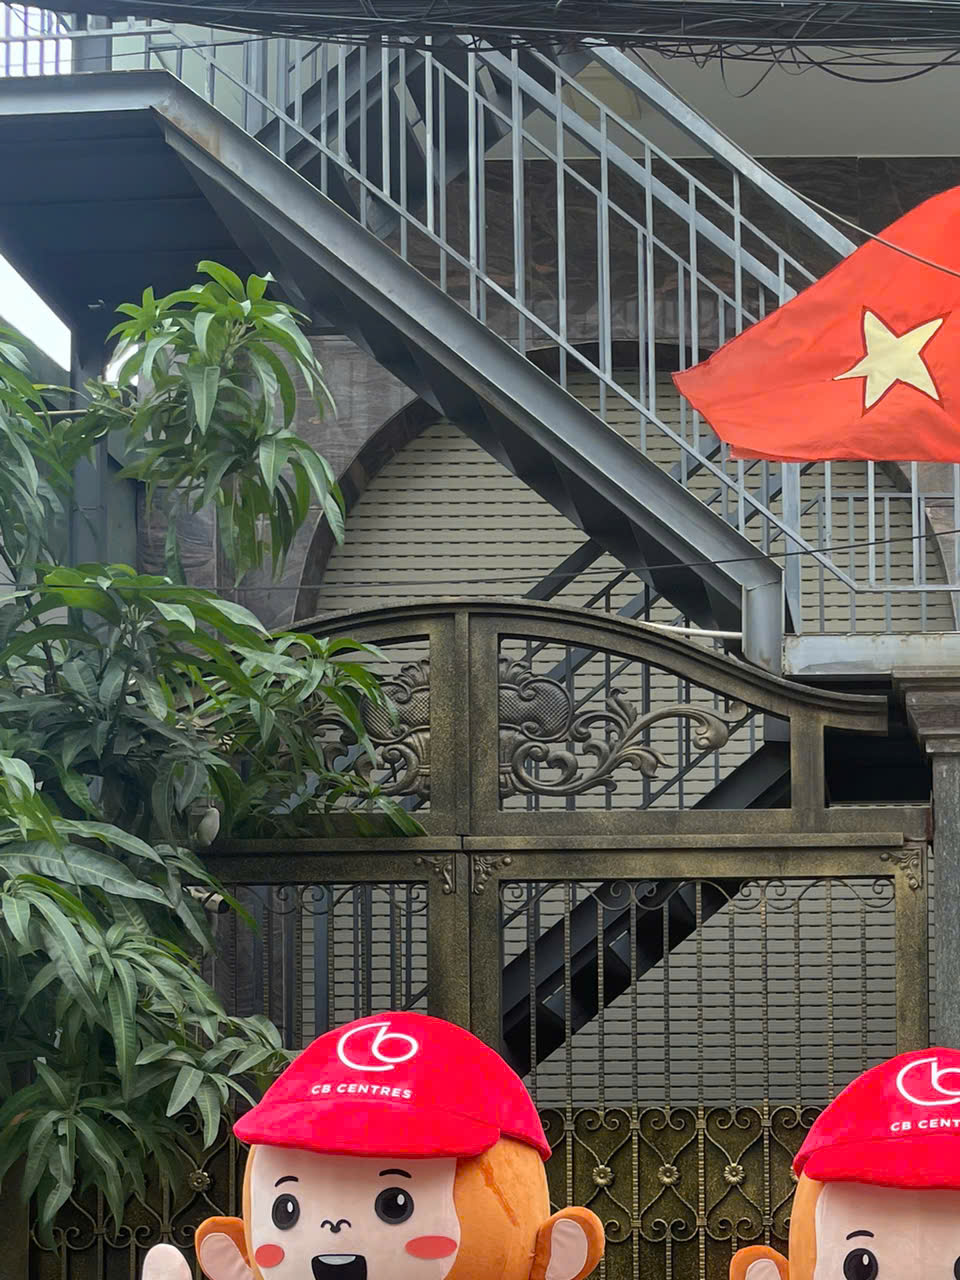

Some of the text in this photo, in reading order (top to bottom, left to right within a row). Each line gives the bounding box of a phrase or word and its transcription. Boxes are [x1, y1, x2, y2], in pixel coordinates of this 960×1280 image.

[311, 1083, 412, 1099] CB CENTRES
[890, 1121, 912, 1132] CB
